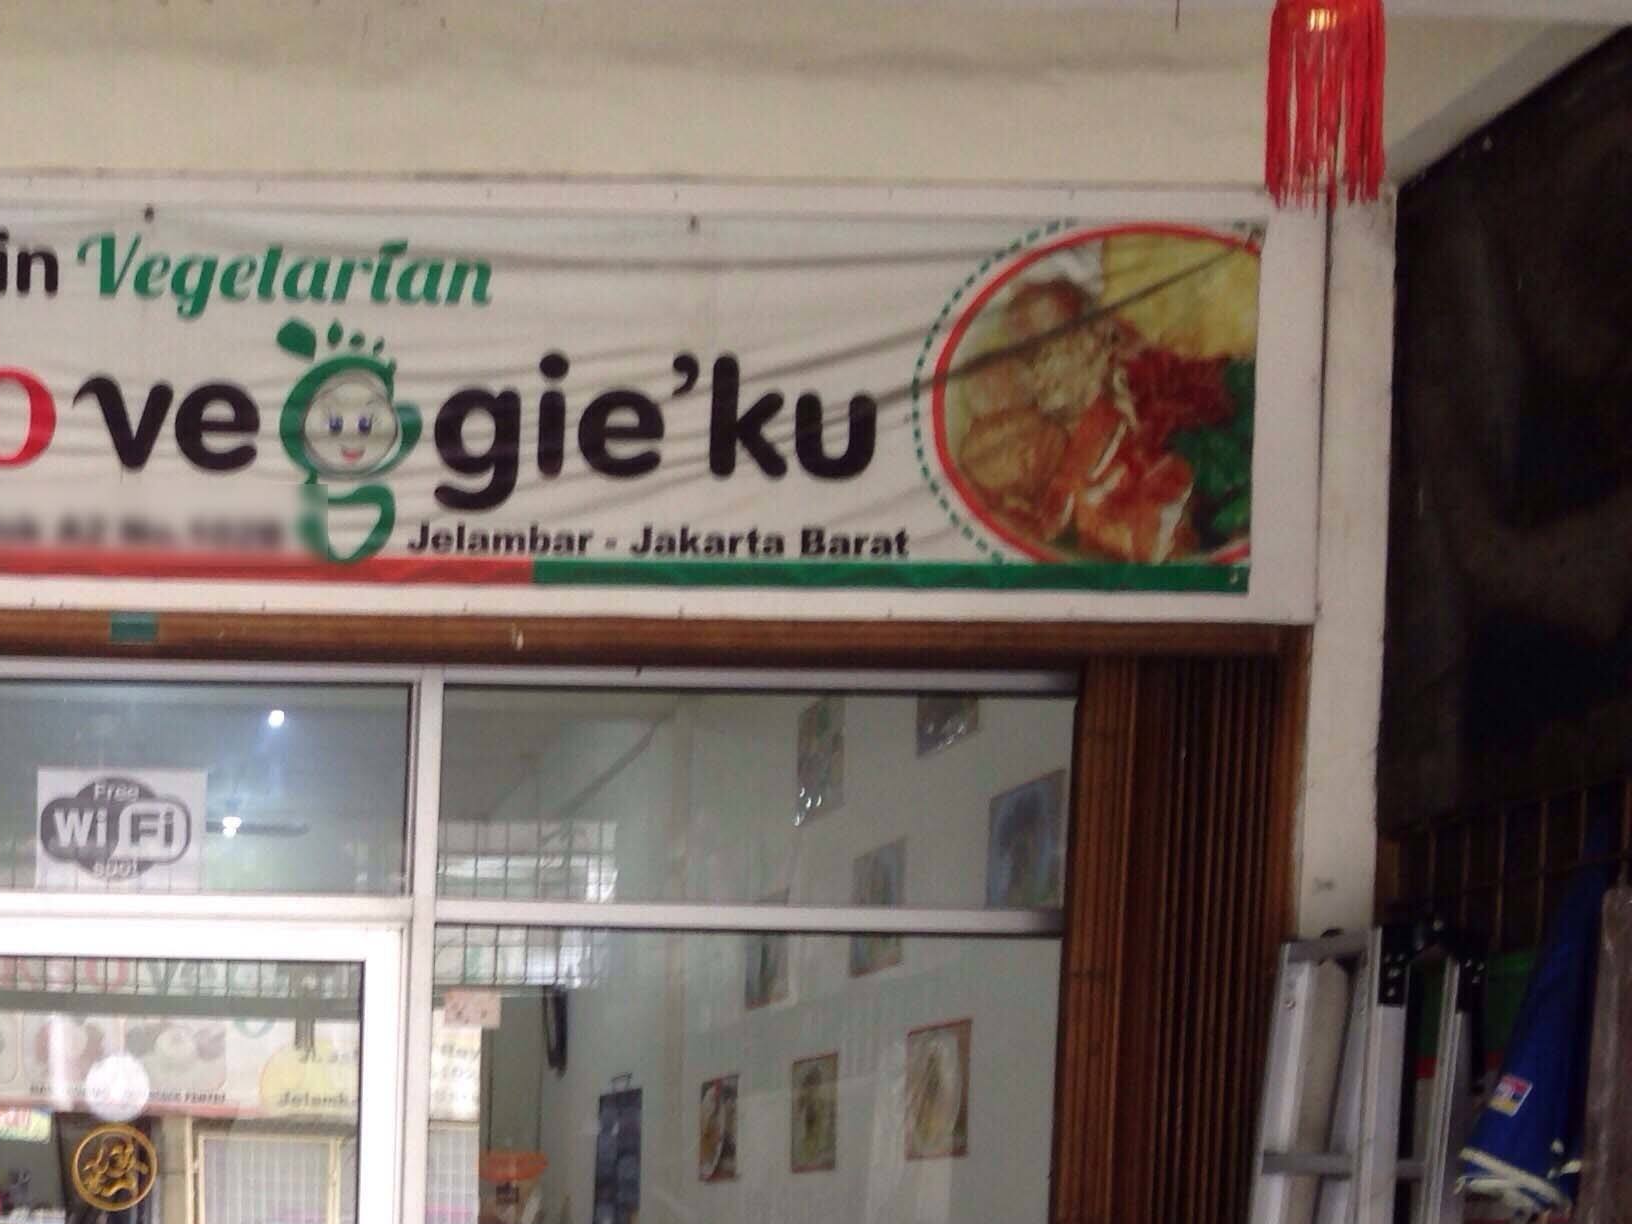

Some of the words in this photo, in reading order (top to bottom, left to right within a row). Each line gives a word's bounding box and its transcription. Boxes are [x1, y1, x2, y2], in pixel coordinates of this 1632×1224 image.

[77, 231, 494, 319] Vegetarian
[407, 524, 593, 557] Jelambar
[631, 525, 782, 558] Jakarta
[801, 527, 910, 558] Barat
